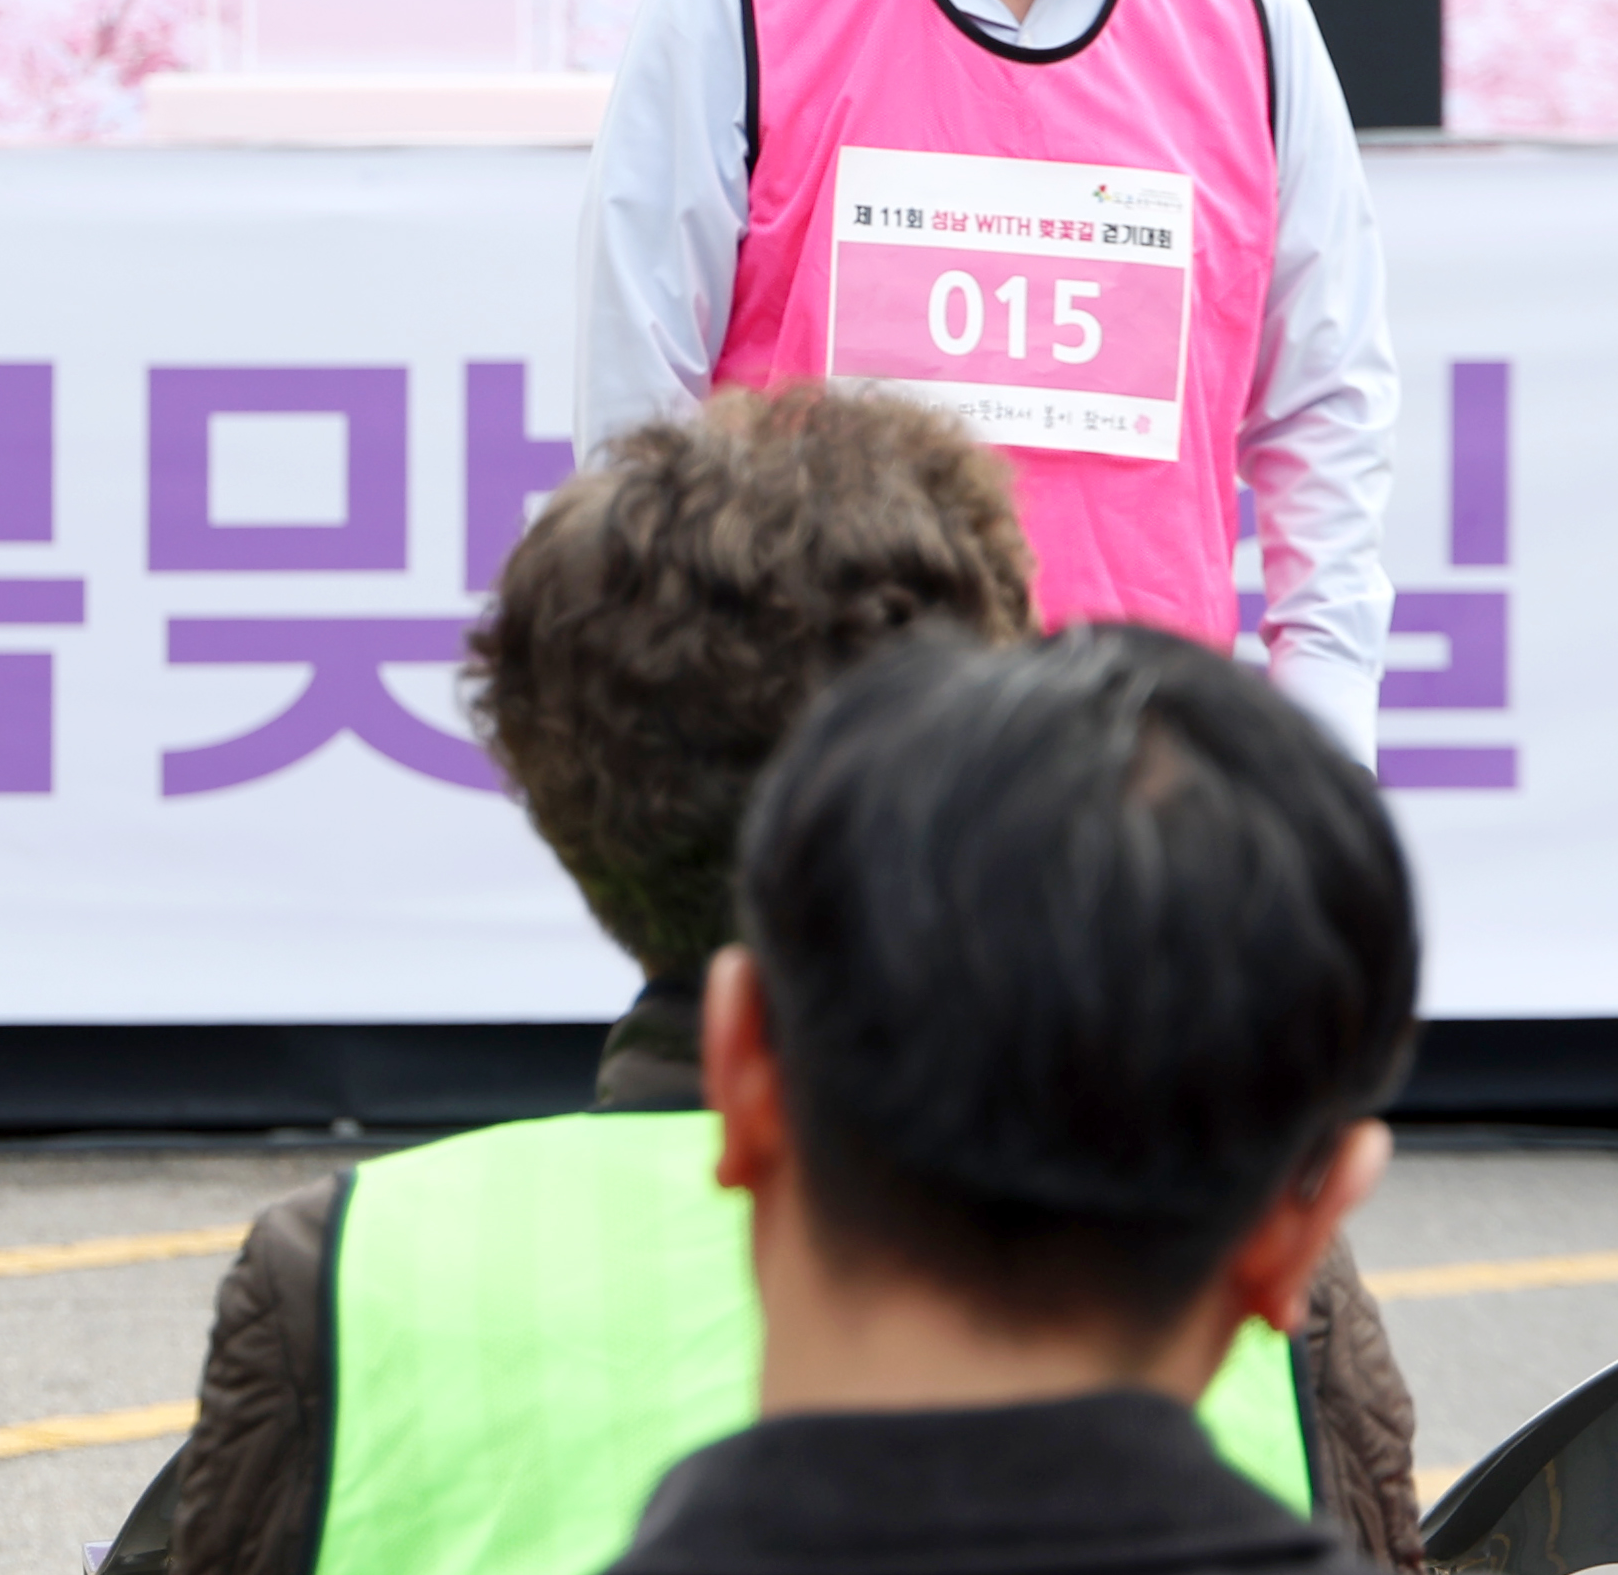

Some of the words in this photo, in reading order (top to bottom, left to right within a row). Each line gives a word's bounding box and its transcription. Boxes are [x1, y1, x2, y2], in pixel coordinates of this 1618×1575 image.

[854, 204, 872, 226] 제
[881, 208, 923, 229] 11회
[932, 209, 969, 233] 성남
[975, 214, 1032, 238] WITH
[1038, 218, 1095, 243] 벚꽃길
[1102, 222, 1173, 250] 걷기대회
[927, 269, 1103, 364] 015
